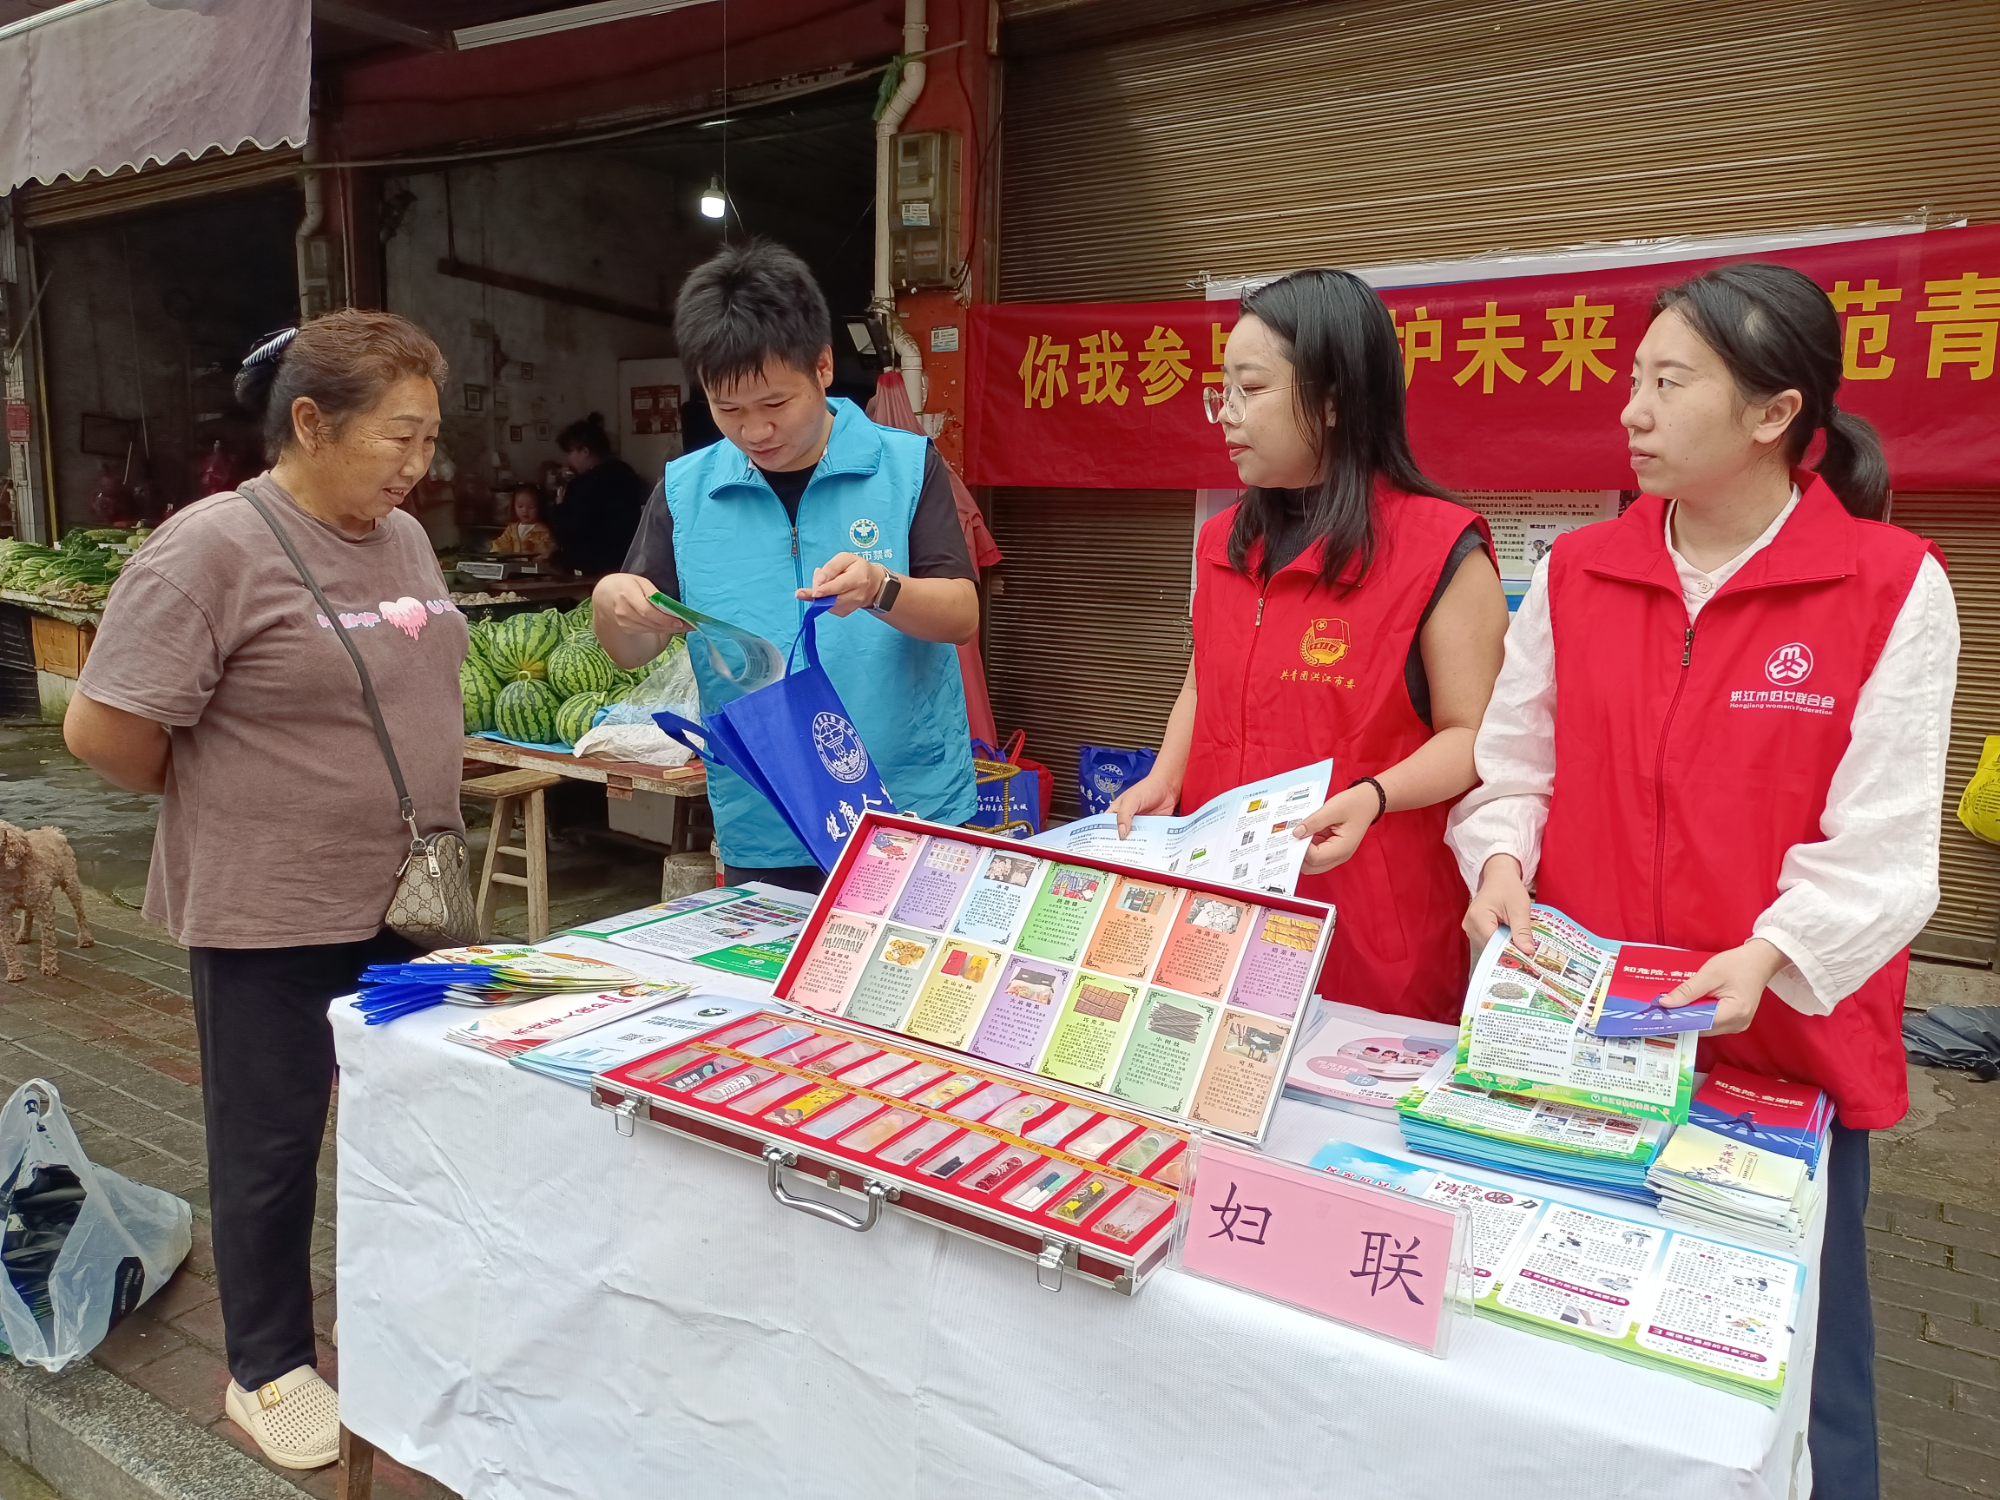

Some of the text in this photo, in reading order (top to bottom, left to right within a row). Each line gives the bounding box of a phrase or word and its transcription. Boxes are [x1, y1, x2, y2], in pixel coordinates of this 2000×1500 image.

[1399, 293, 1617, 396] 护未来
[1826, 272, 2000, 381] 范青
[1280, 669, 1356, 689] 共青团洪江市委
[1729, 690, 1836, 709] 洪江市妇女联合会
[1795, 706, 1833, 715] Federation
[1155, 1036, 1181, 1048] 小树枝
[1238, 1060, 1255, 1069] 可乐
[1208, 1181, 1425, 1306] 妇联
